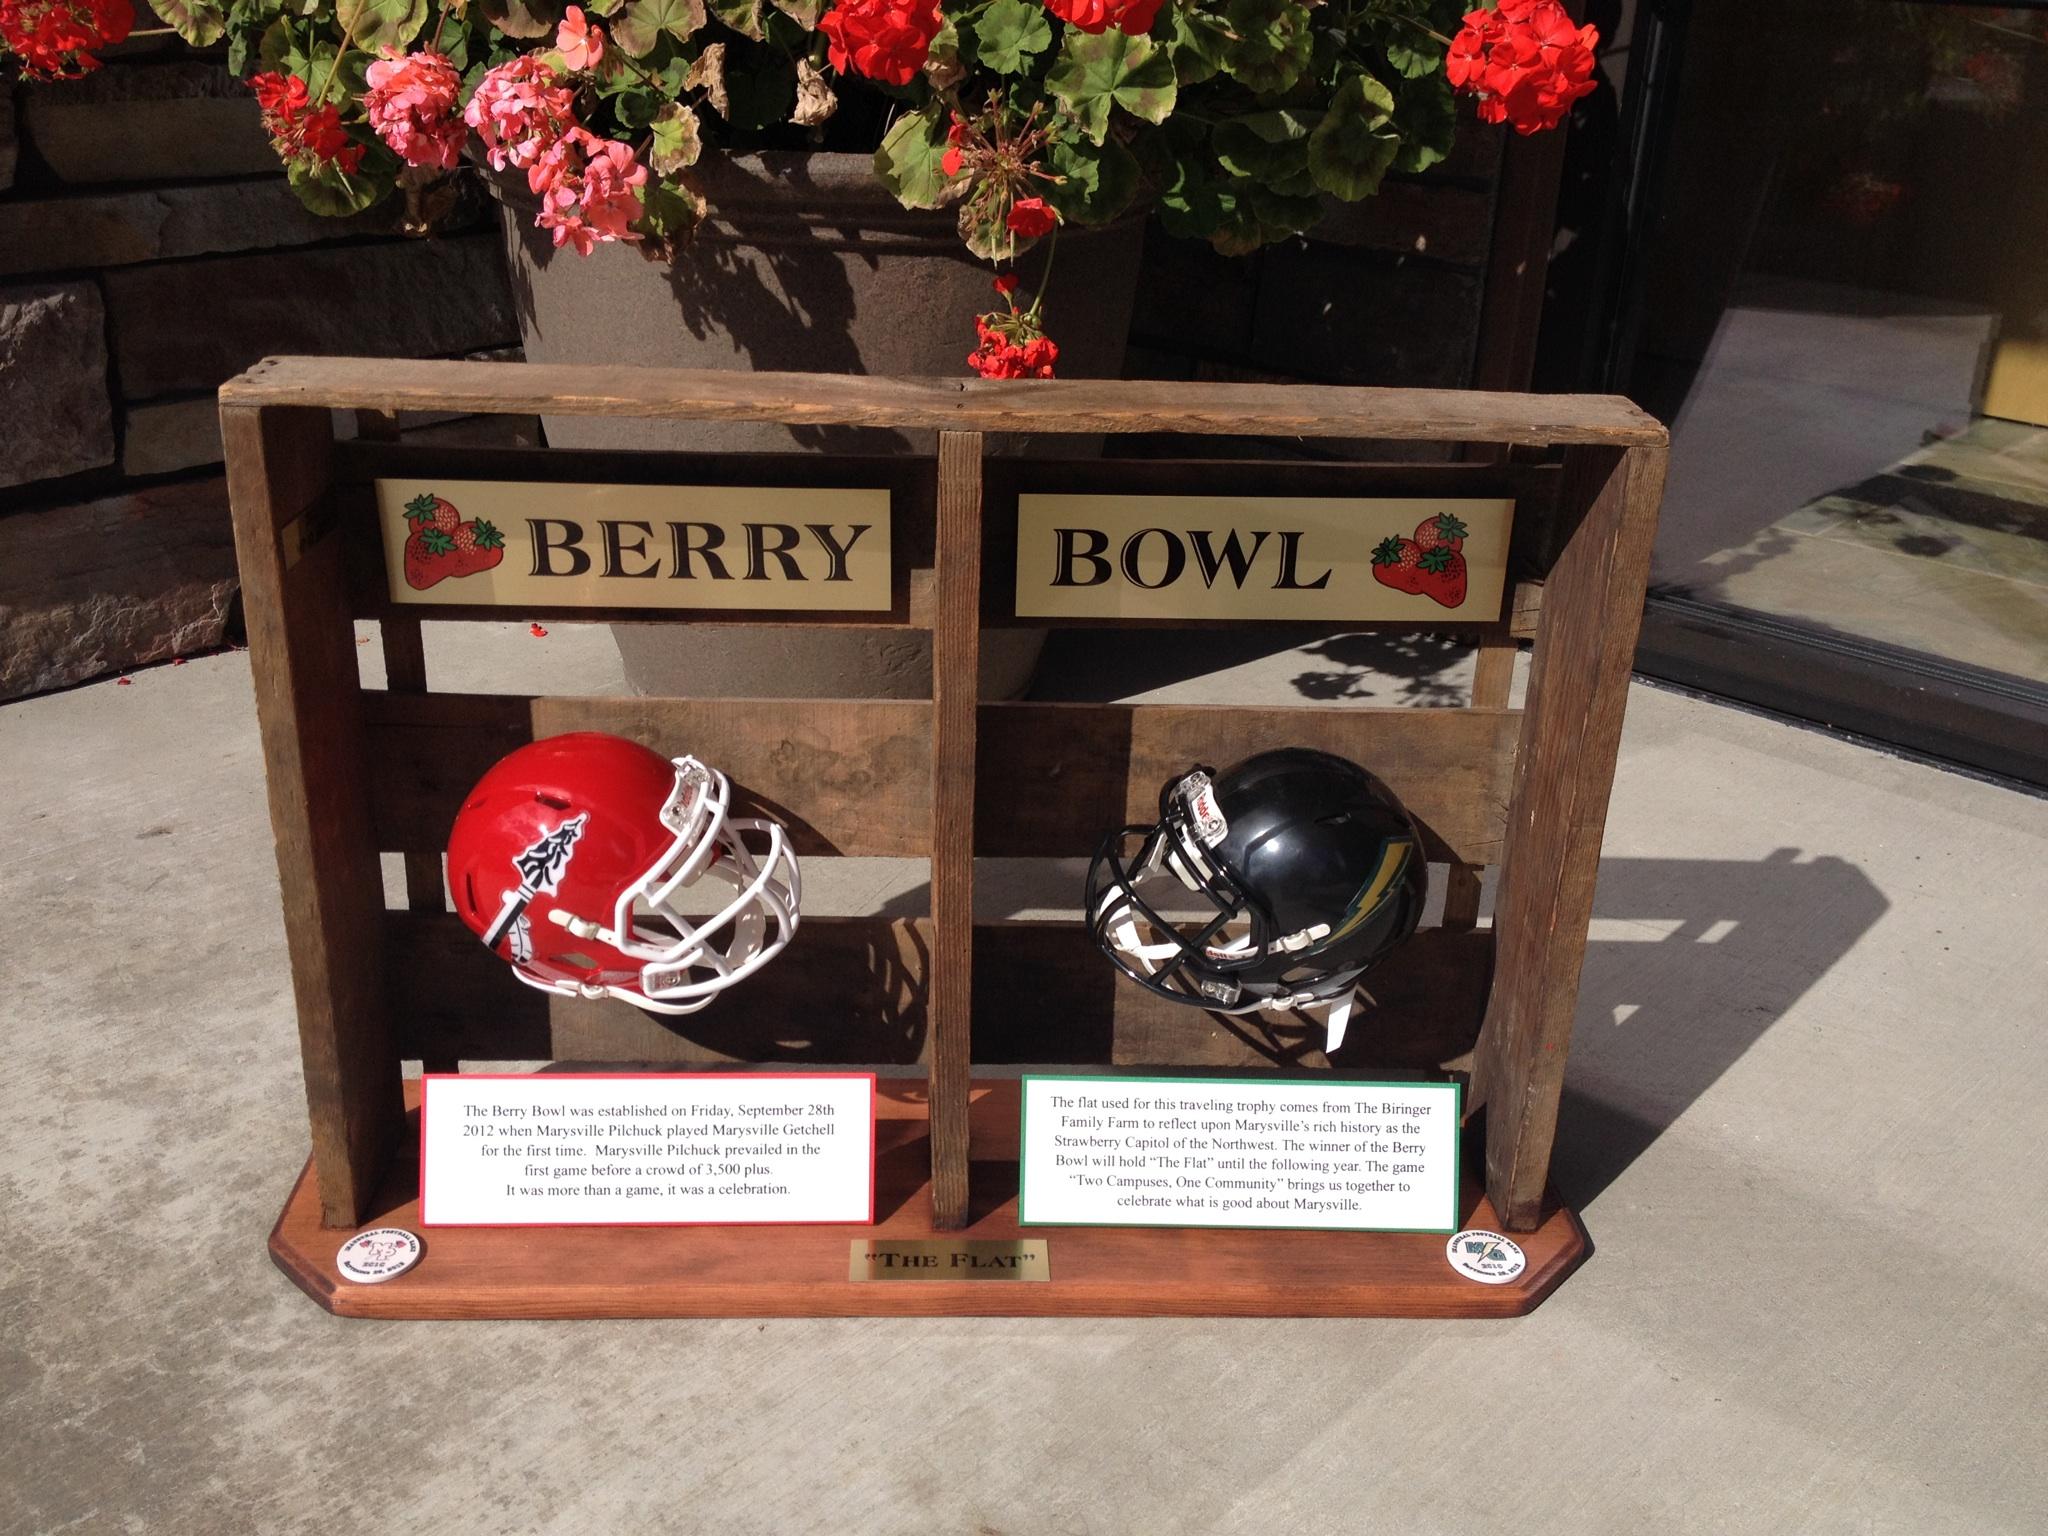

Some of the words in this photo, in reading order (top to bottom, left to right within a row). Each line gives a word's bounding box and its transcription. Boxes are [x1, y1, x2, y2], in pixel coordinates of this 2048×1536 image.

[524, 517, 872, 581] BERRY
[1049, 528, 1332, 590] BOWL
[463, 1104, 488, 1117] The
[492, 1104, 527, 1120] Berry
[532, 1104, 565, 1117] Bowl
[569, 1108, 594, 1117] was
[597, 1104, 668, 1117] established
[671, 1108, 687, 1117] on
[691, 1104, 734, 1120] Friday,
[738, 1104, 804, 1120] September
[807, 1103, 835, 1116] 28th
[1050, 1095, 1074, 1108] The
[1078, 1096, 1098, 1109] flat
[1101, 1097, 1129, 1109] used
[1133, 1097, 1151, 1110] for
[1154, 1098, 1176, 1110] this
[1179, 1099, 1234, 1114] traveling
[1236, 1099, 1276, 1115] trophy
[1279, 1103, 1319, 1113] comes
[1322, 1101, 1351, 1114] from
[1354, 1101, 1378, 1114] The
[1381, 1102, 1432, 1118] Biringer
[463, 1124, 494, 1137] 2012
[498, 1124, 532, 1137] when
[536, 1124, 605, 1140] Marysville
[608, 1124, 663, 1137] Pilchuck
[666, 1123, 708, 1140] played
[712, 1123, 779, 1139] Marysville
[782, 1123, 835, 1136] Getchell
[1061, 1115, 1104, 1131] Family
[1108, 1116, 1139, 1129] Farm
[1143, 1118, 1155, 1129] to
[1158, 1117, 1197, 1130] reflect
[1200, 1121, 1231, 1134] upon
[1313, 1120, 1337, 1133] rich
[1340, 1120, 1381, 1137] history
[1385, 1125, 1399, 1134] as
[1401, 1122, 1421, 1134] the
[481, 1144, 499, 1157] for
[503, 1144, 522, 1157] the
[526, 1144, 551, 1157] first
[555, 1144, 587, 1157] time.
[595, 1143, 663, 1160] Marysville
[667, 1143, 721, 1156] Pilchuck
[725, 1143, 782, 1159] prevailed
[786, 1143, 798, 1155] in
[802, 1143, 821, 1155] the
[1054, 1135, 1121, 1151] Strawberry
[1125, 1136, 1169, 1152] Capitol
[1173, 1136, 1188, 1149] of
[1189, 1137, 1208, 1150] the
[1212, 1137, 1278, 1151] Northwest.
[1281, 1139, 1305, 1152] The
[1308, 1140, 1351, 1152] winner
[1353, 1140, 1369, 1153] of
[1370, 1140, 1389, 1153] the
[1392, 1141, 1426, 1157] Berry
[524, 1163, 549, 1177] first
[553, 1167, 588, 1180] game
[591, 1163, 632, 1176] before
[635, 1167, 642, 1176] a
[645, 1163, 685, 1176] crowd
[688, 1163, 704, 1176] of
[706, 1163, 741, 1177] 3,500
[744, 1163, 775, 1179] plus.
[1055, 1154, 1088, 1167] Bowl
[1091, 1155, 1115, 1167] will
[1119, 1155, 1146, 1168] hold
[1217, 1157, 1245, 1170] until
[1248, 1157, 1268, 1170] the
[1271, 1158, 1330, 1174] following
[1333, 1162, 1361, 1175] year.
[1364, 1160, 1389, 1173] The
[1392, 1163, 1425, 1176] game
[506, 1184, 515, 1196] It
[519, 1187, 544, 1196] was
[547, 1187, 580, 1196] more
[583, 1183, 611, 1196] than
[614, 1187, 622, 1196] a
[625, 1186, 664, 1199] game,
[667, 1183, 676, 1196] it
[680, 1186, 704, 1195] was
[707, 1186, 715, 1195] a
[718, 1182, 791, 1195] celebration.
[1106, 1175, 1172, 1191] Campuses,
[1175, 1176, 1202, 1188] One
[1287, 1178, 1325, 1194] brings
[1328, 1182, 1342, 1191] us
[1345, 1179, 1396, 1195] together
[1398, 1180, 1411, 1192] to
[1117, 1194, 1172, 1207] celebrate
[1175, 1195, 1204, 1208] what
[1209, 1195, 1219, 1208] is
[1222, 1196, 1253, 1211] good
[1256, 1196, 1290, 1209] about
[1294, 1197, 1362, 1213] Marysville.
